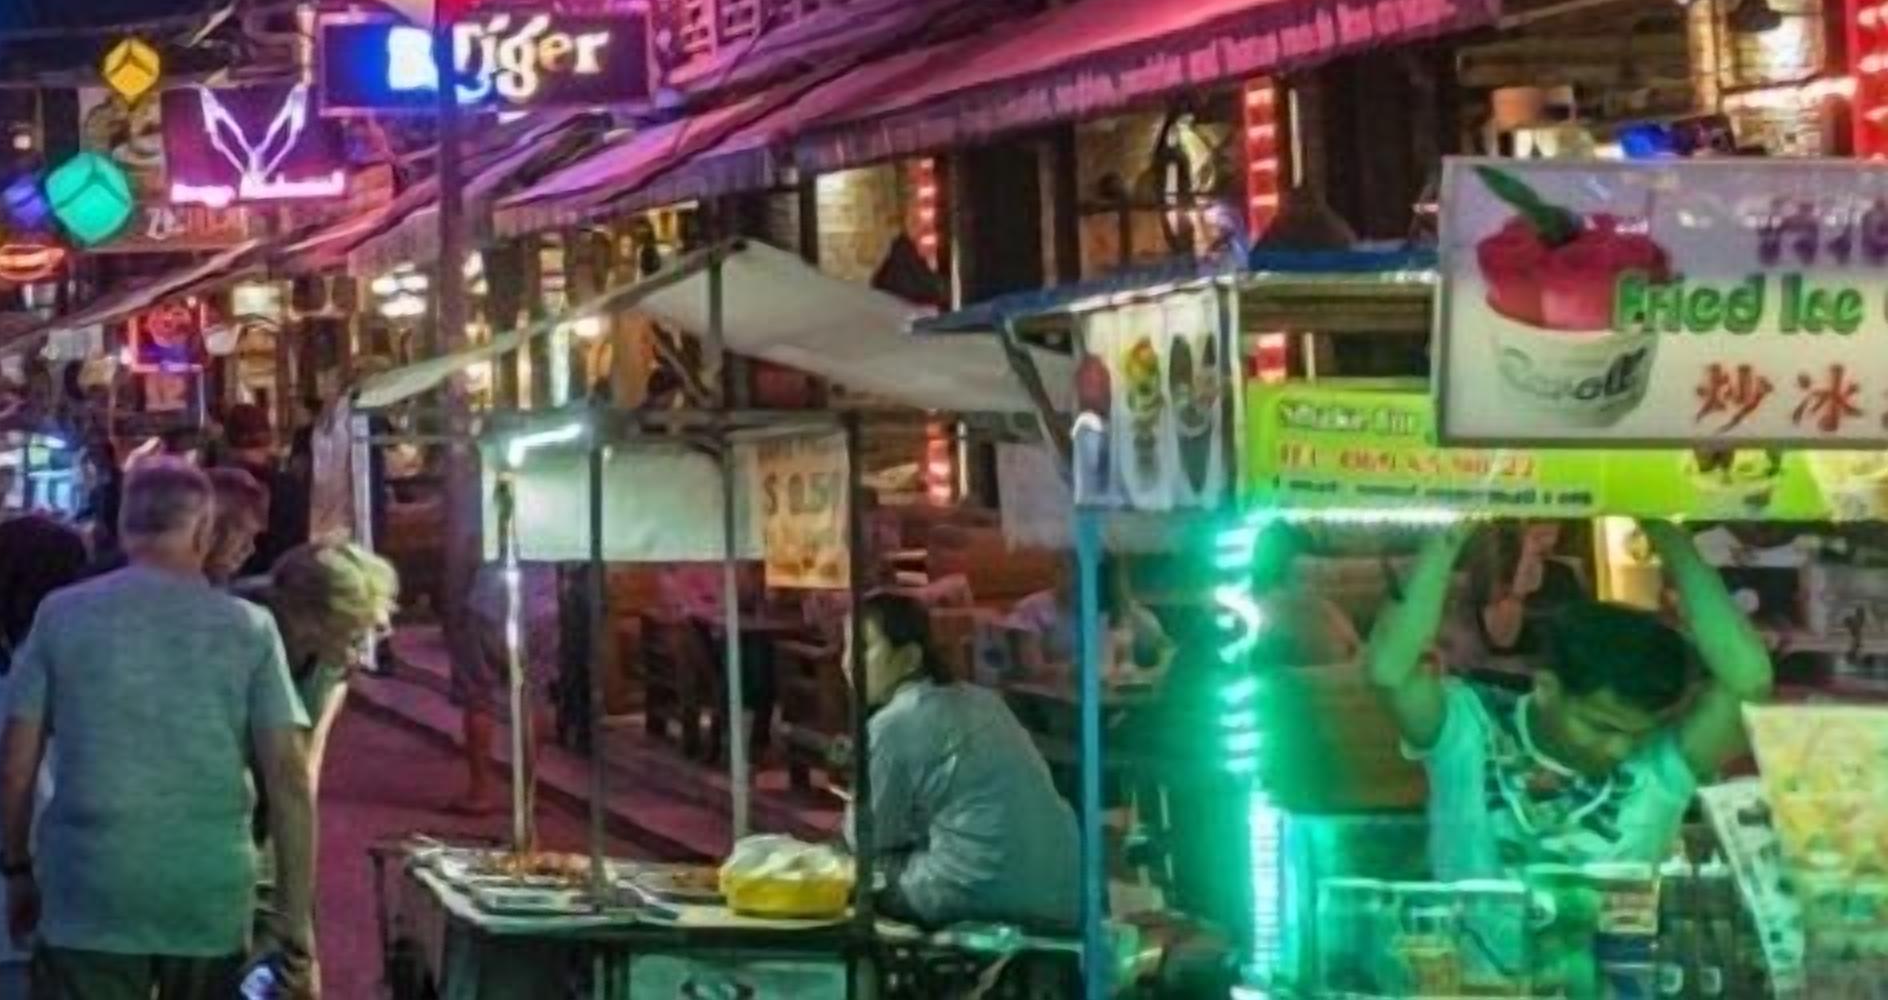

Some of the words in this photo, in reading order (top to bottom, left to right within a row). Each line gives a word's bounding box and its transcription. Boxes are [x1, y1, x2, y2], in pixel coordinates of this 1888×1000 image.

[1613, 270, 1767, 334] Fried
[1778, 271, 1864, 335] Ice
[1694, 362, 1888, 433] 炒冰
